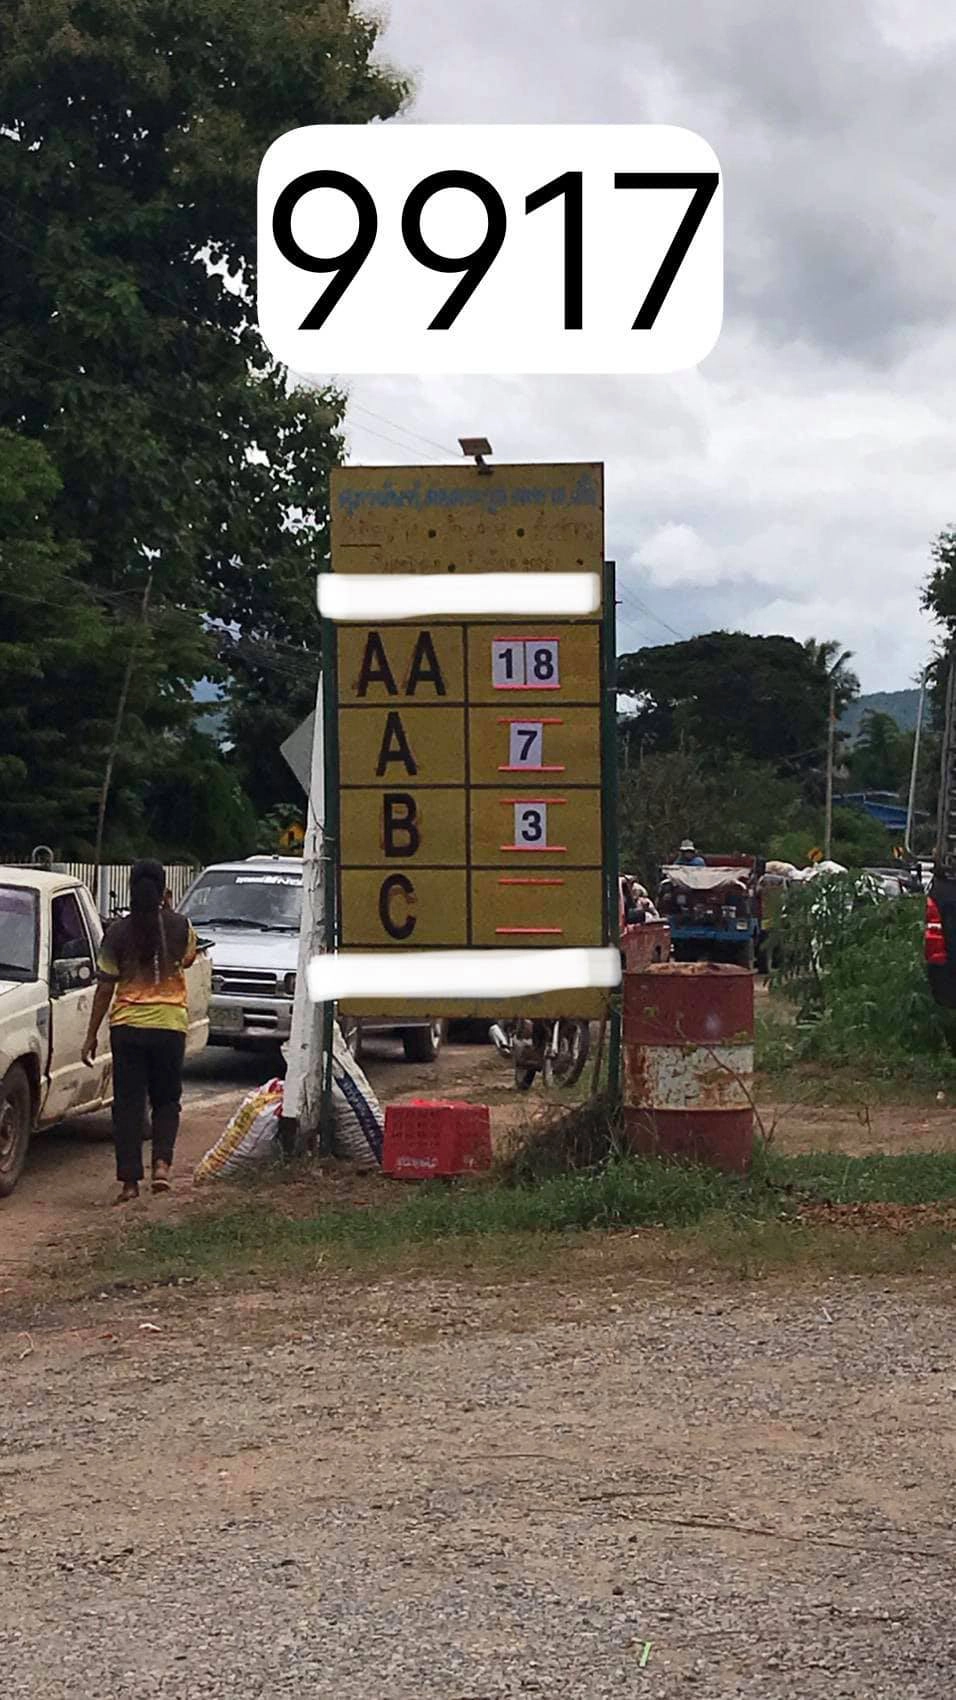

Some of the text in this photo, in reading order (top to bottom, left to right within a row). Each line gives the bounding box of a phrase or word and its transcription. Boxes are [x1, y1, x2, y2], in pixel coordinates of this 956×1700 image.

[499, 648, 554, 680] 18
[375, 711, 539, 777] A 7
[383, 793, 543, 859] B 3
[378, 873, 417, 941] C
